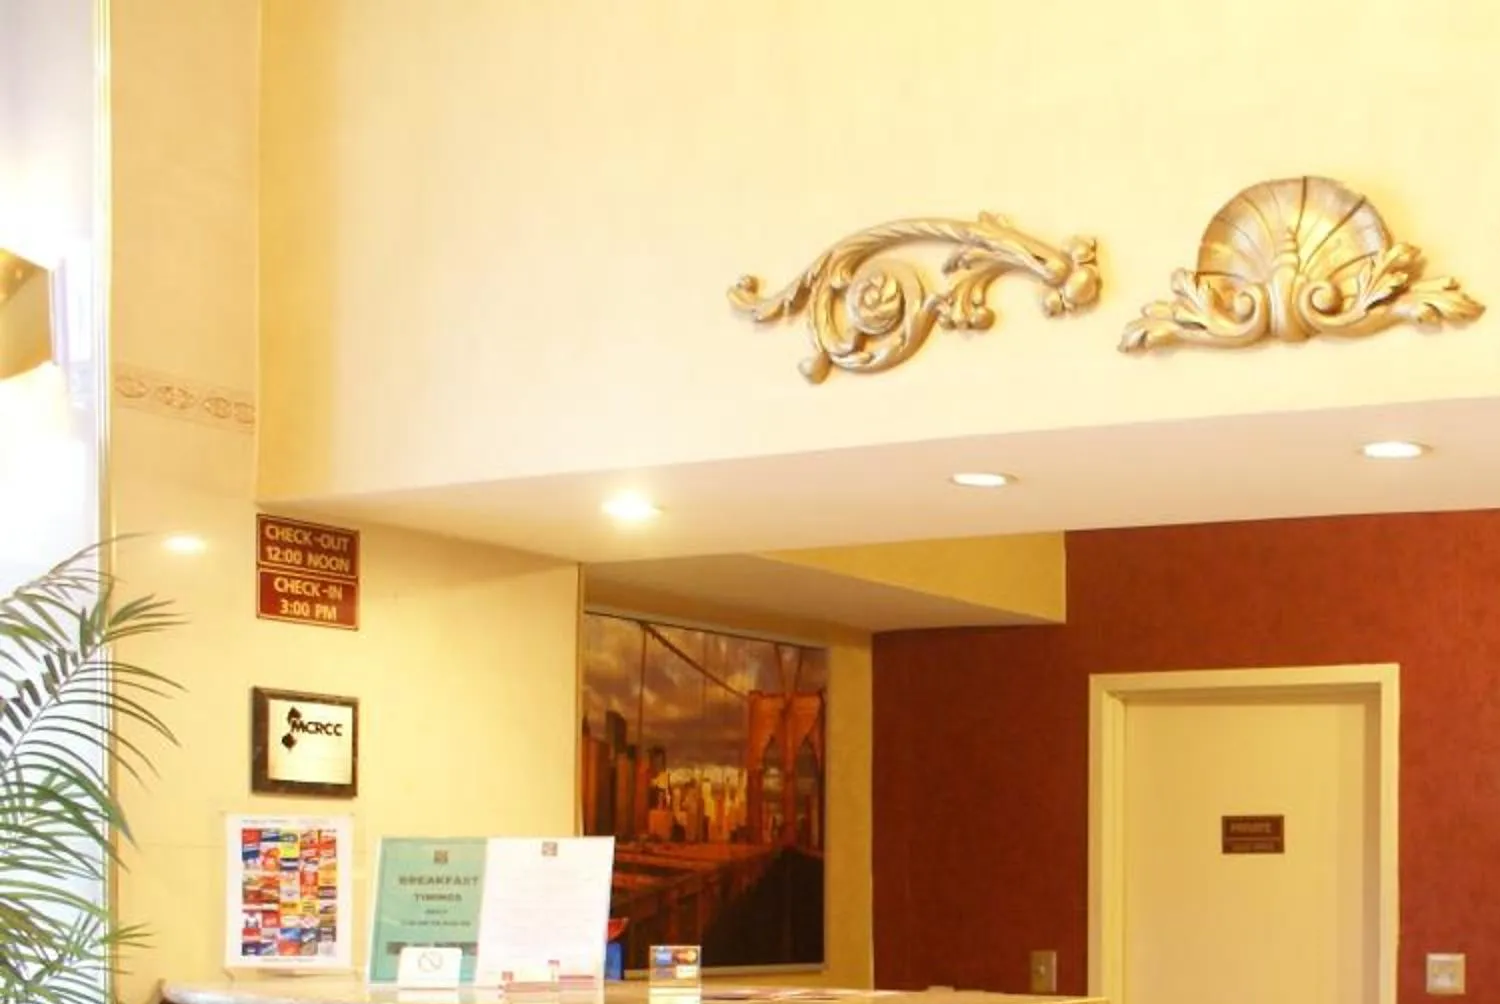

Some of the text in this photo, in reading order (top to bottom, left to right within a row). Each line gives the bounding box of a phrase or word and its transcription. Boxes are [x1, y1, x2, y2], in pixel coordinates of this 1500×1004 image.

[265, 524, 350, 552] CHECK-OUT
[266, 546, 350, 572] 12:00 NOON
[274, 577, 342, 600] CHECK-IN
[280, 598, 337, 620] 3:00 PM
[291, 719, 343, 737] MCRCC
[398, 875, 480, 887] BREAKFAST
